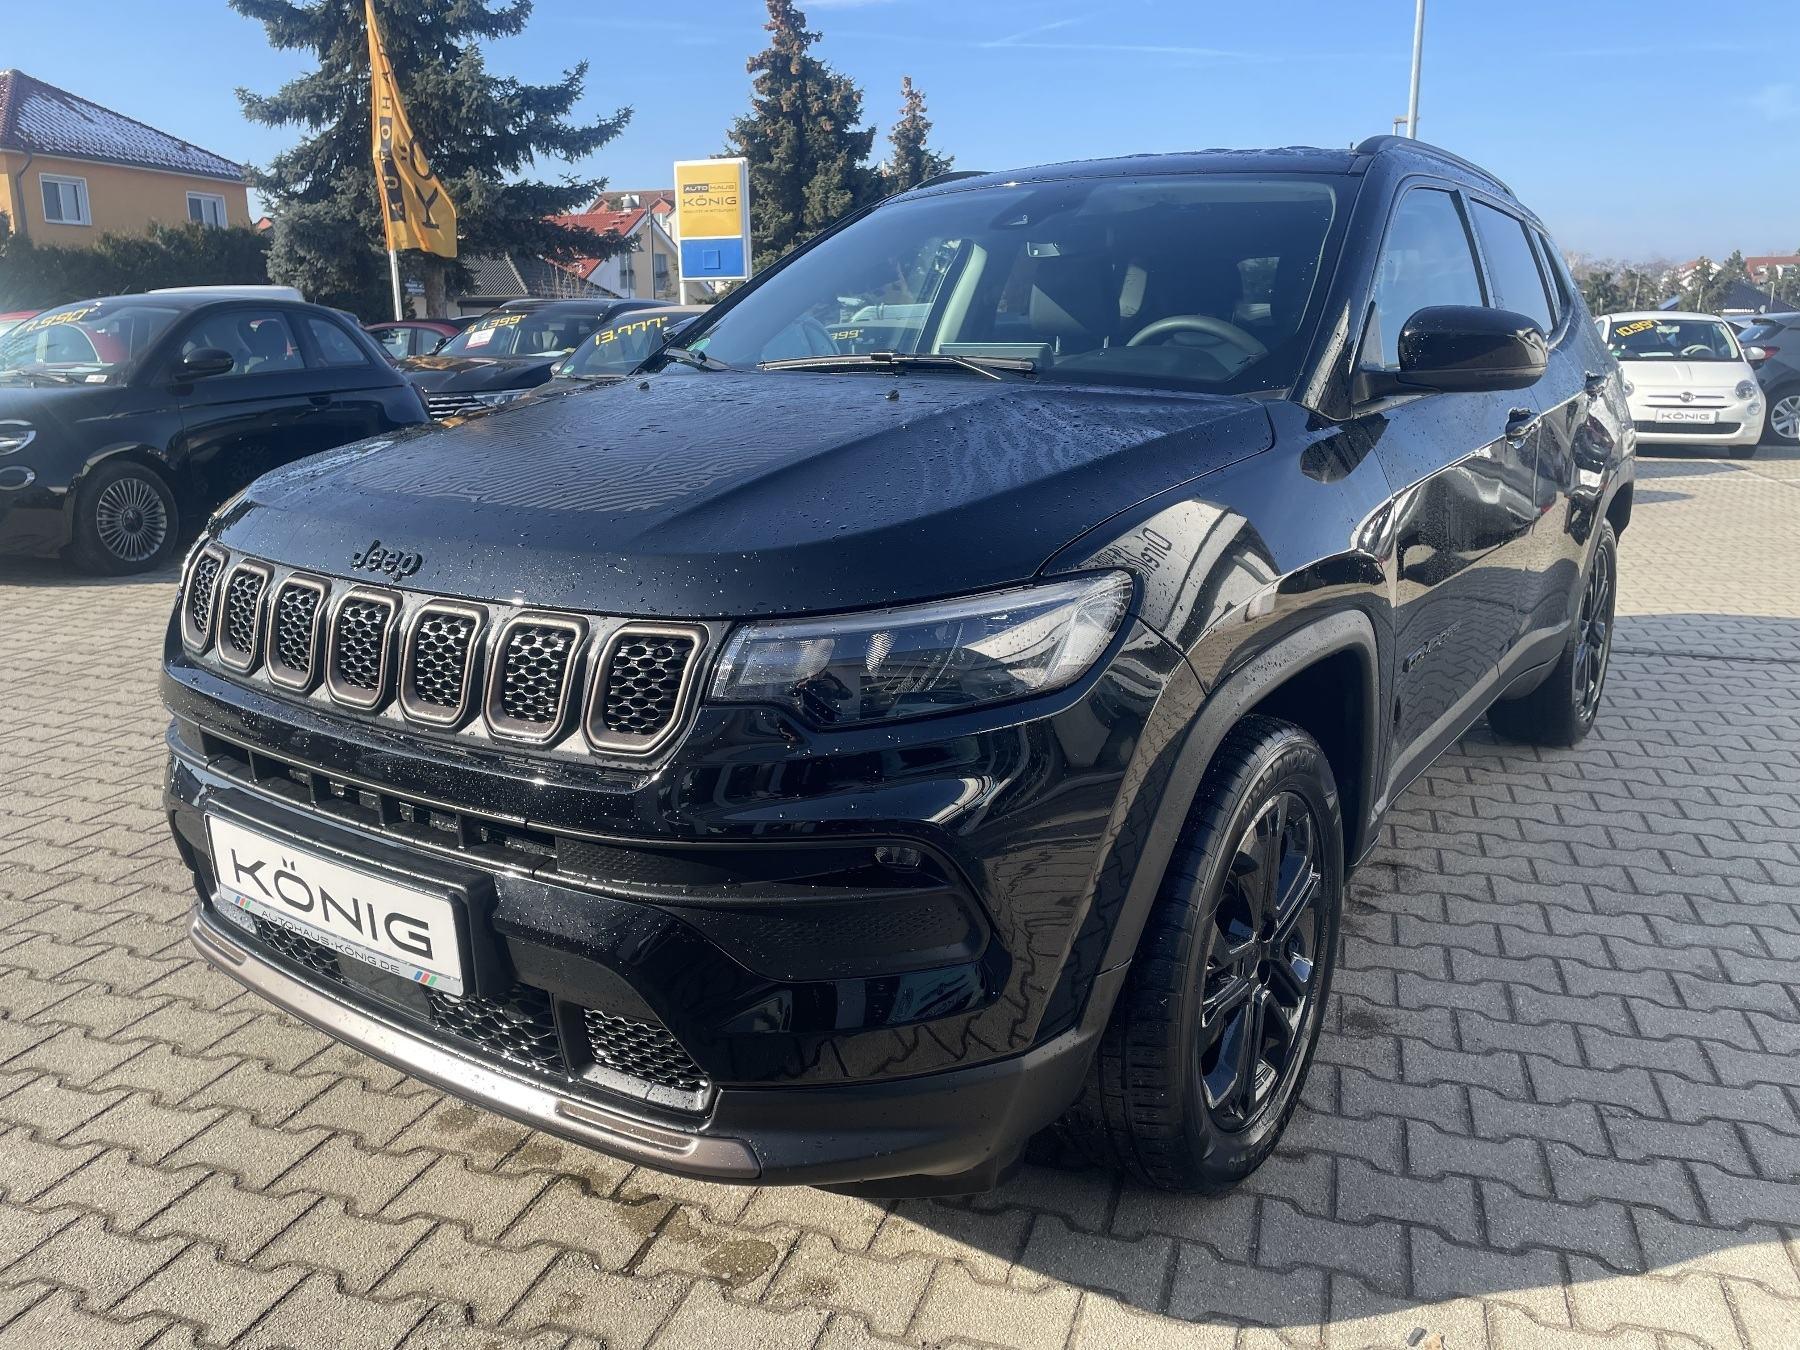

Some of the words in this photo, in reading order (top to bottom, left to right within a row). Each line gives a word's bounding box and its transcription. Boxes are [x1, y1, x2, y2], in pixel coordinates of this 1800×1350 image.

[682, 194, 737, 207] KÖNIG
[1661, 411, 1710, 420] KÖNIG
[350, 540, 423, 582] Jeep
[231, 848, 434, 961] KÖNIG
